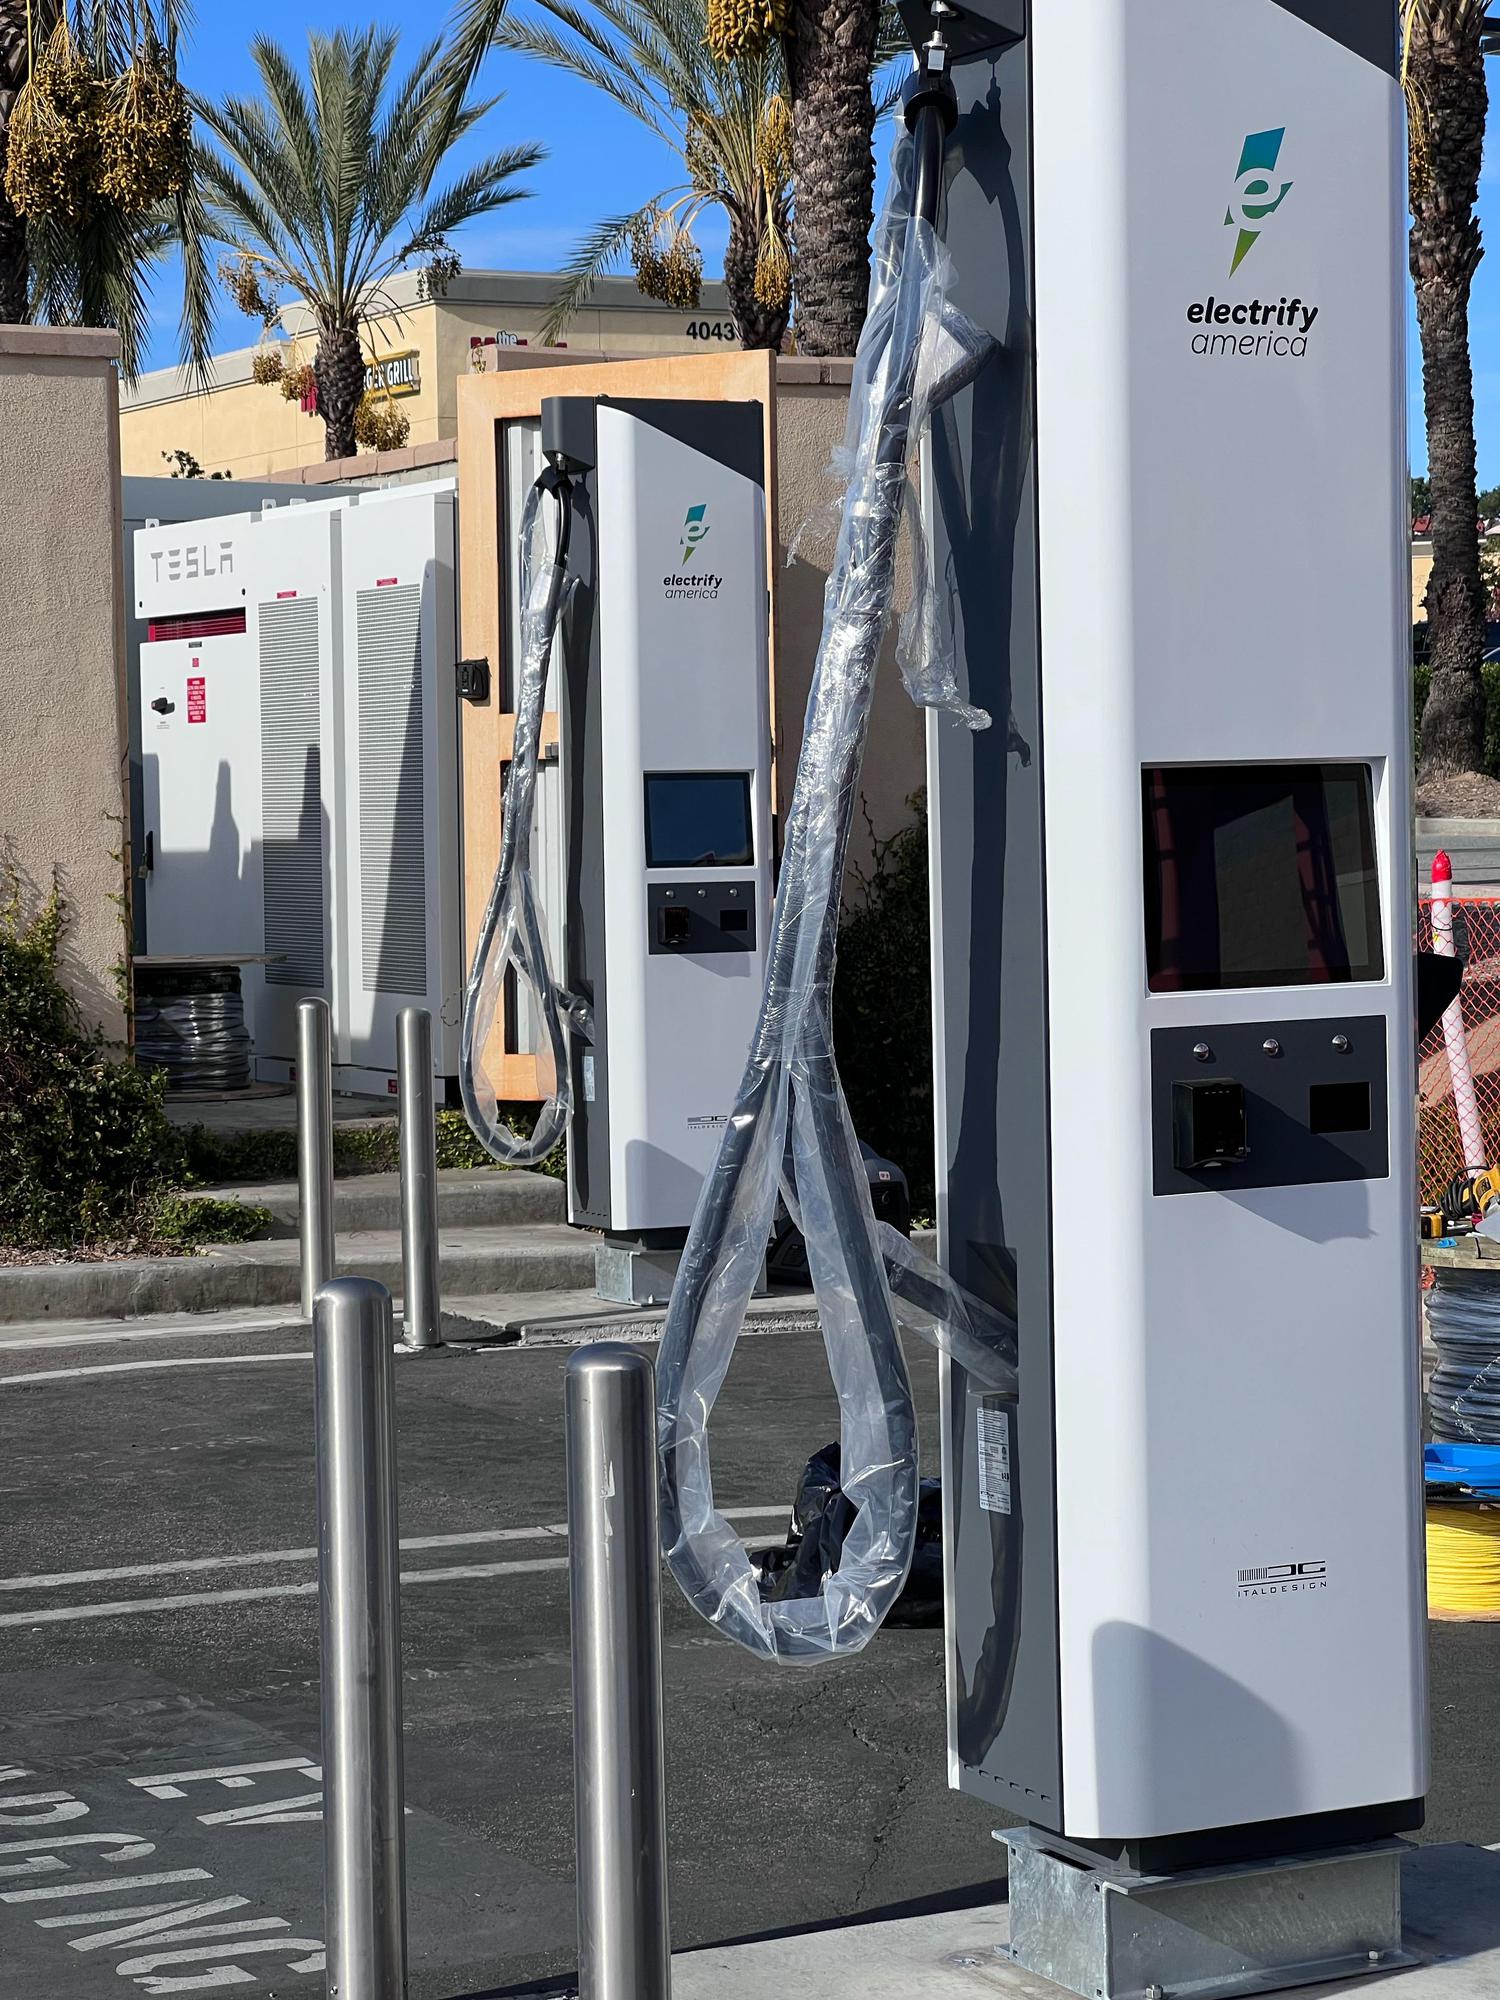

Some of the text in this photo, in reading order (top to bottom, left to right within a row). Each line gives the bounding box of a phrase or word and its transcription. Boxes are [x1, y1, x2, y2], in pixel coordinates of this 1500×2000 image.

[1186, 296, 1319, 334] electrify
[686, 321, 736, 341] 4043
[1191, 330, 1308, 357] america
[387, 358, 413, 386] GRILL
[150, 541, 233, 582] TESLA
[663, 573, 723, 589] electrify
[665, 588, 718, 599] america
[1238, 1581, 1327, 1597] ITALDESIGN
